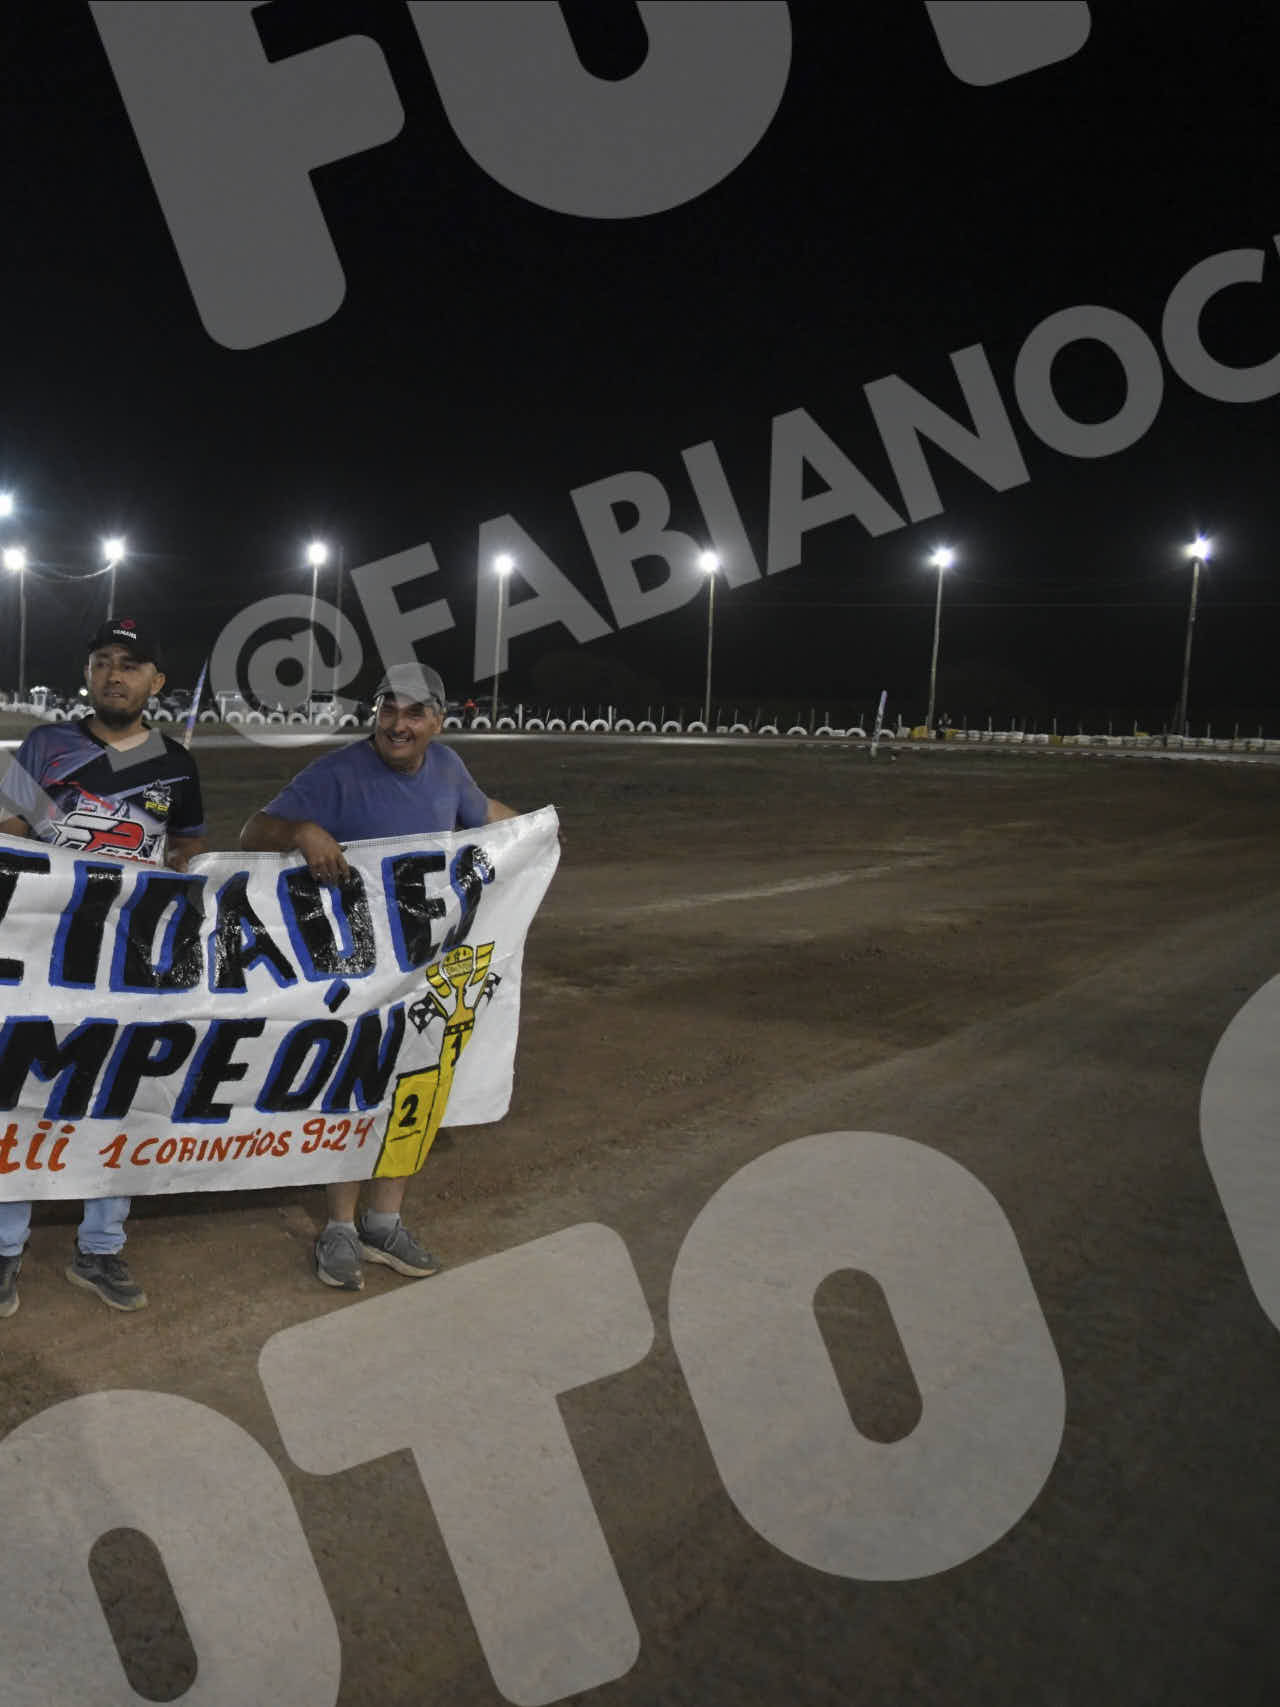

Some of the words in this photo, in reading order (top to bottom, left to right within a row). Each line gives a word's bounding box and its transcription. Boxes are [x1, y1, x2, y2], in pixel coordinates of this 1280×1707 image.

[399, 1094, 419, 1127] 2
[98, 1133, 128, 1169] 1
[301, 1117, 375, 1153] 9:24
